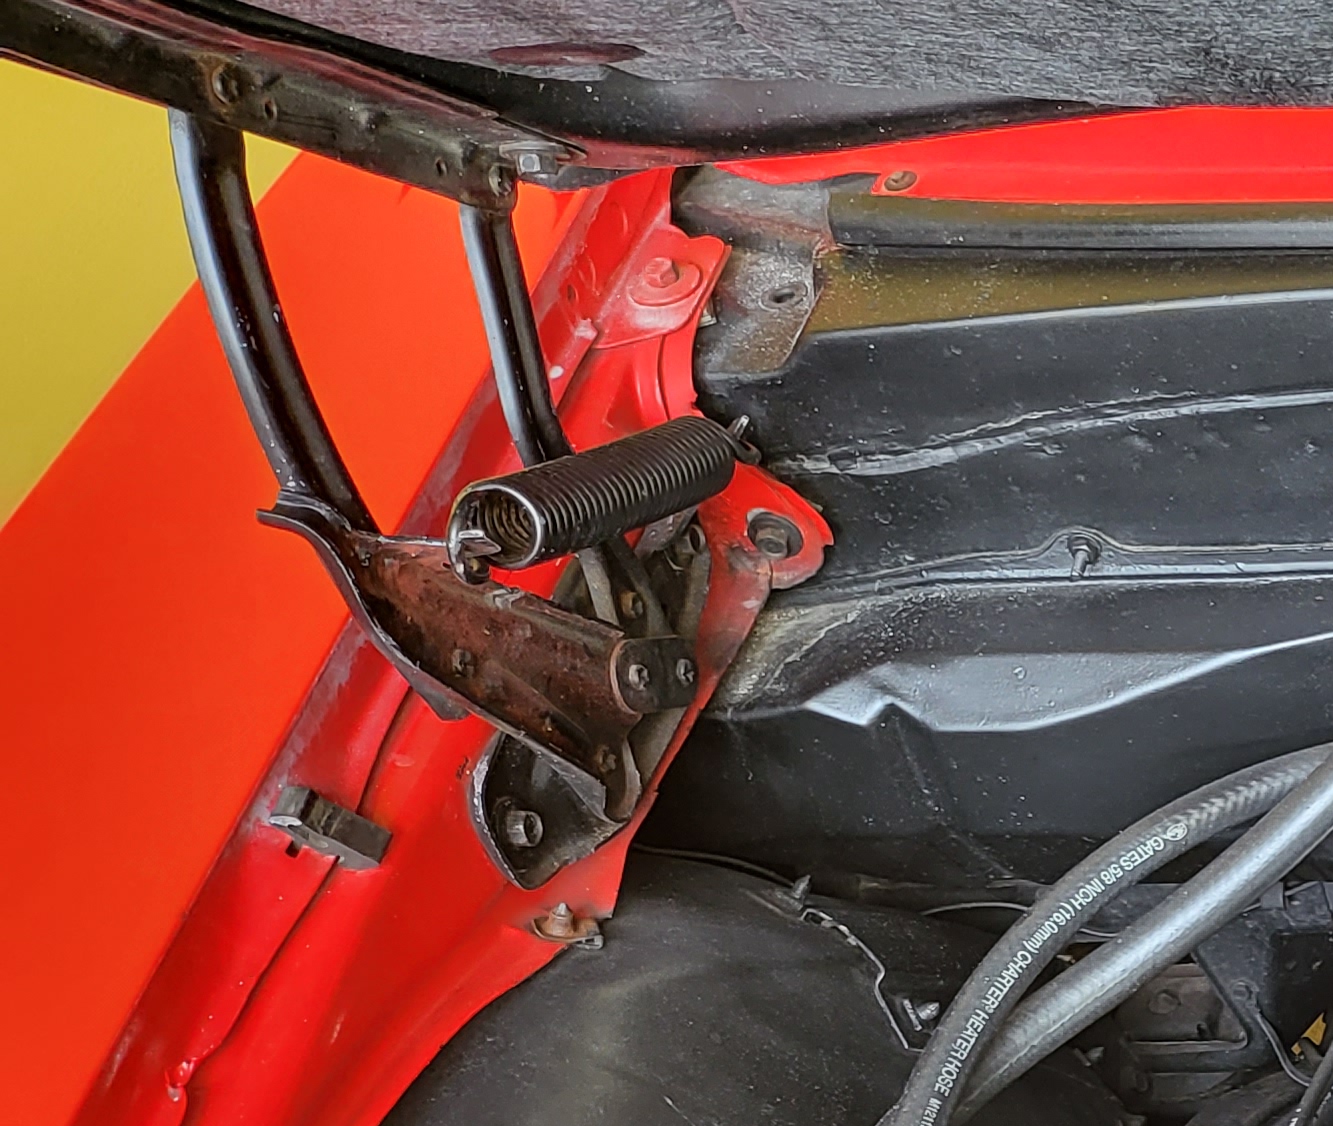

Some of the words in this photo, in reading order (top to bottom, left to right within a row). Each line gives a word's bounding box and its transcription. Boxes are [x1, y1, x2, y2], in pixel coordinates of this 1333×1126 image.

[1120, 838, 1166, 869] GATES
[1101, 862, 1124, 887] 5/8
[1074, 879, 1106, 911] INCH
[1022, 901, 1077, 954] (16.0mm)
[933, 1056, 964, 1097] HOSE
